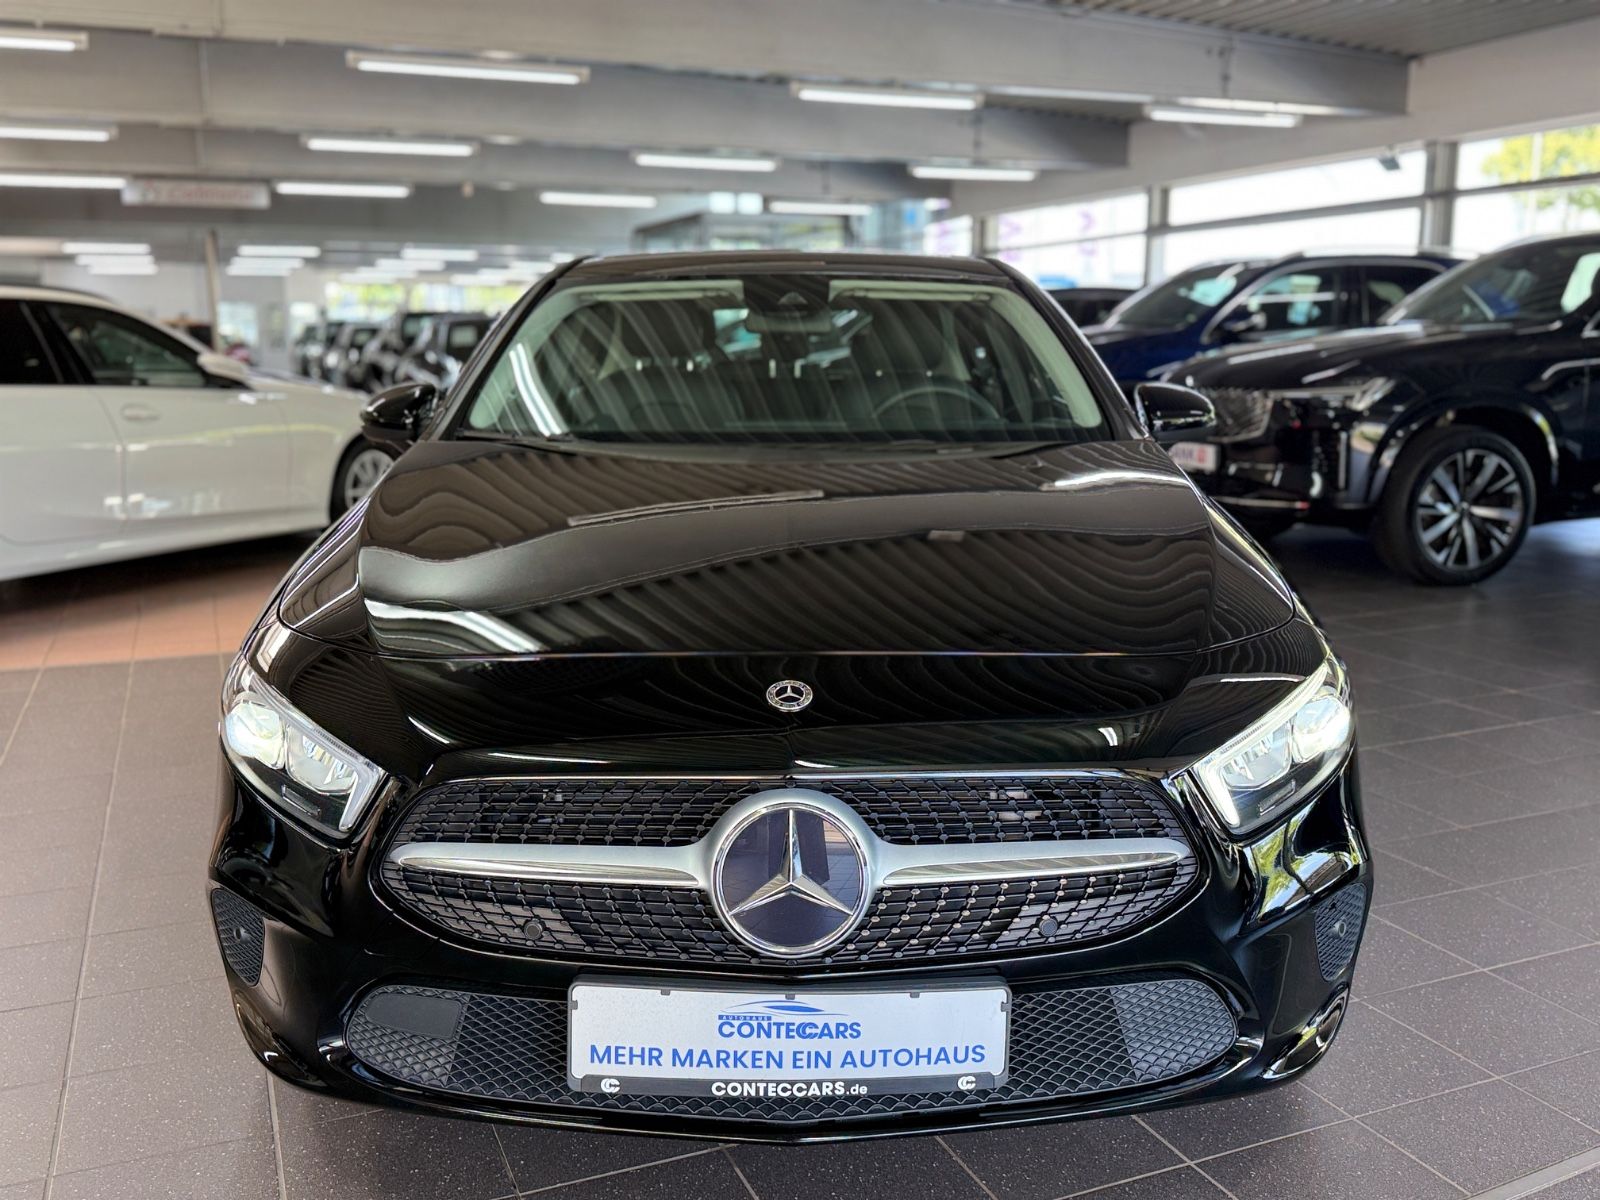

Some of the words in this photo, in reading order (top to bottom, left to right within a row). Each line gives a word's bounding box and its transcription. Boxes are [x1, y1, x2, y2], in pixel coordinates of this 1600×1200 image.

[718, 1021, 861, 1039] CONTECCARS
[590, 1044, 664, 1067] MEHR
[672, 1047, 784, 1070] MARKEN
[793, 1048, 833, 1069] EIN
[839, 1044, 986, 1069] AUTOHAUS
[711, 1080, 868, 1096] CONTECCARS.de
